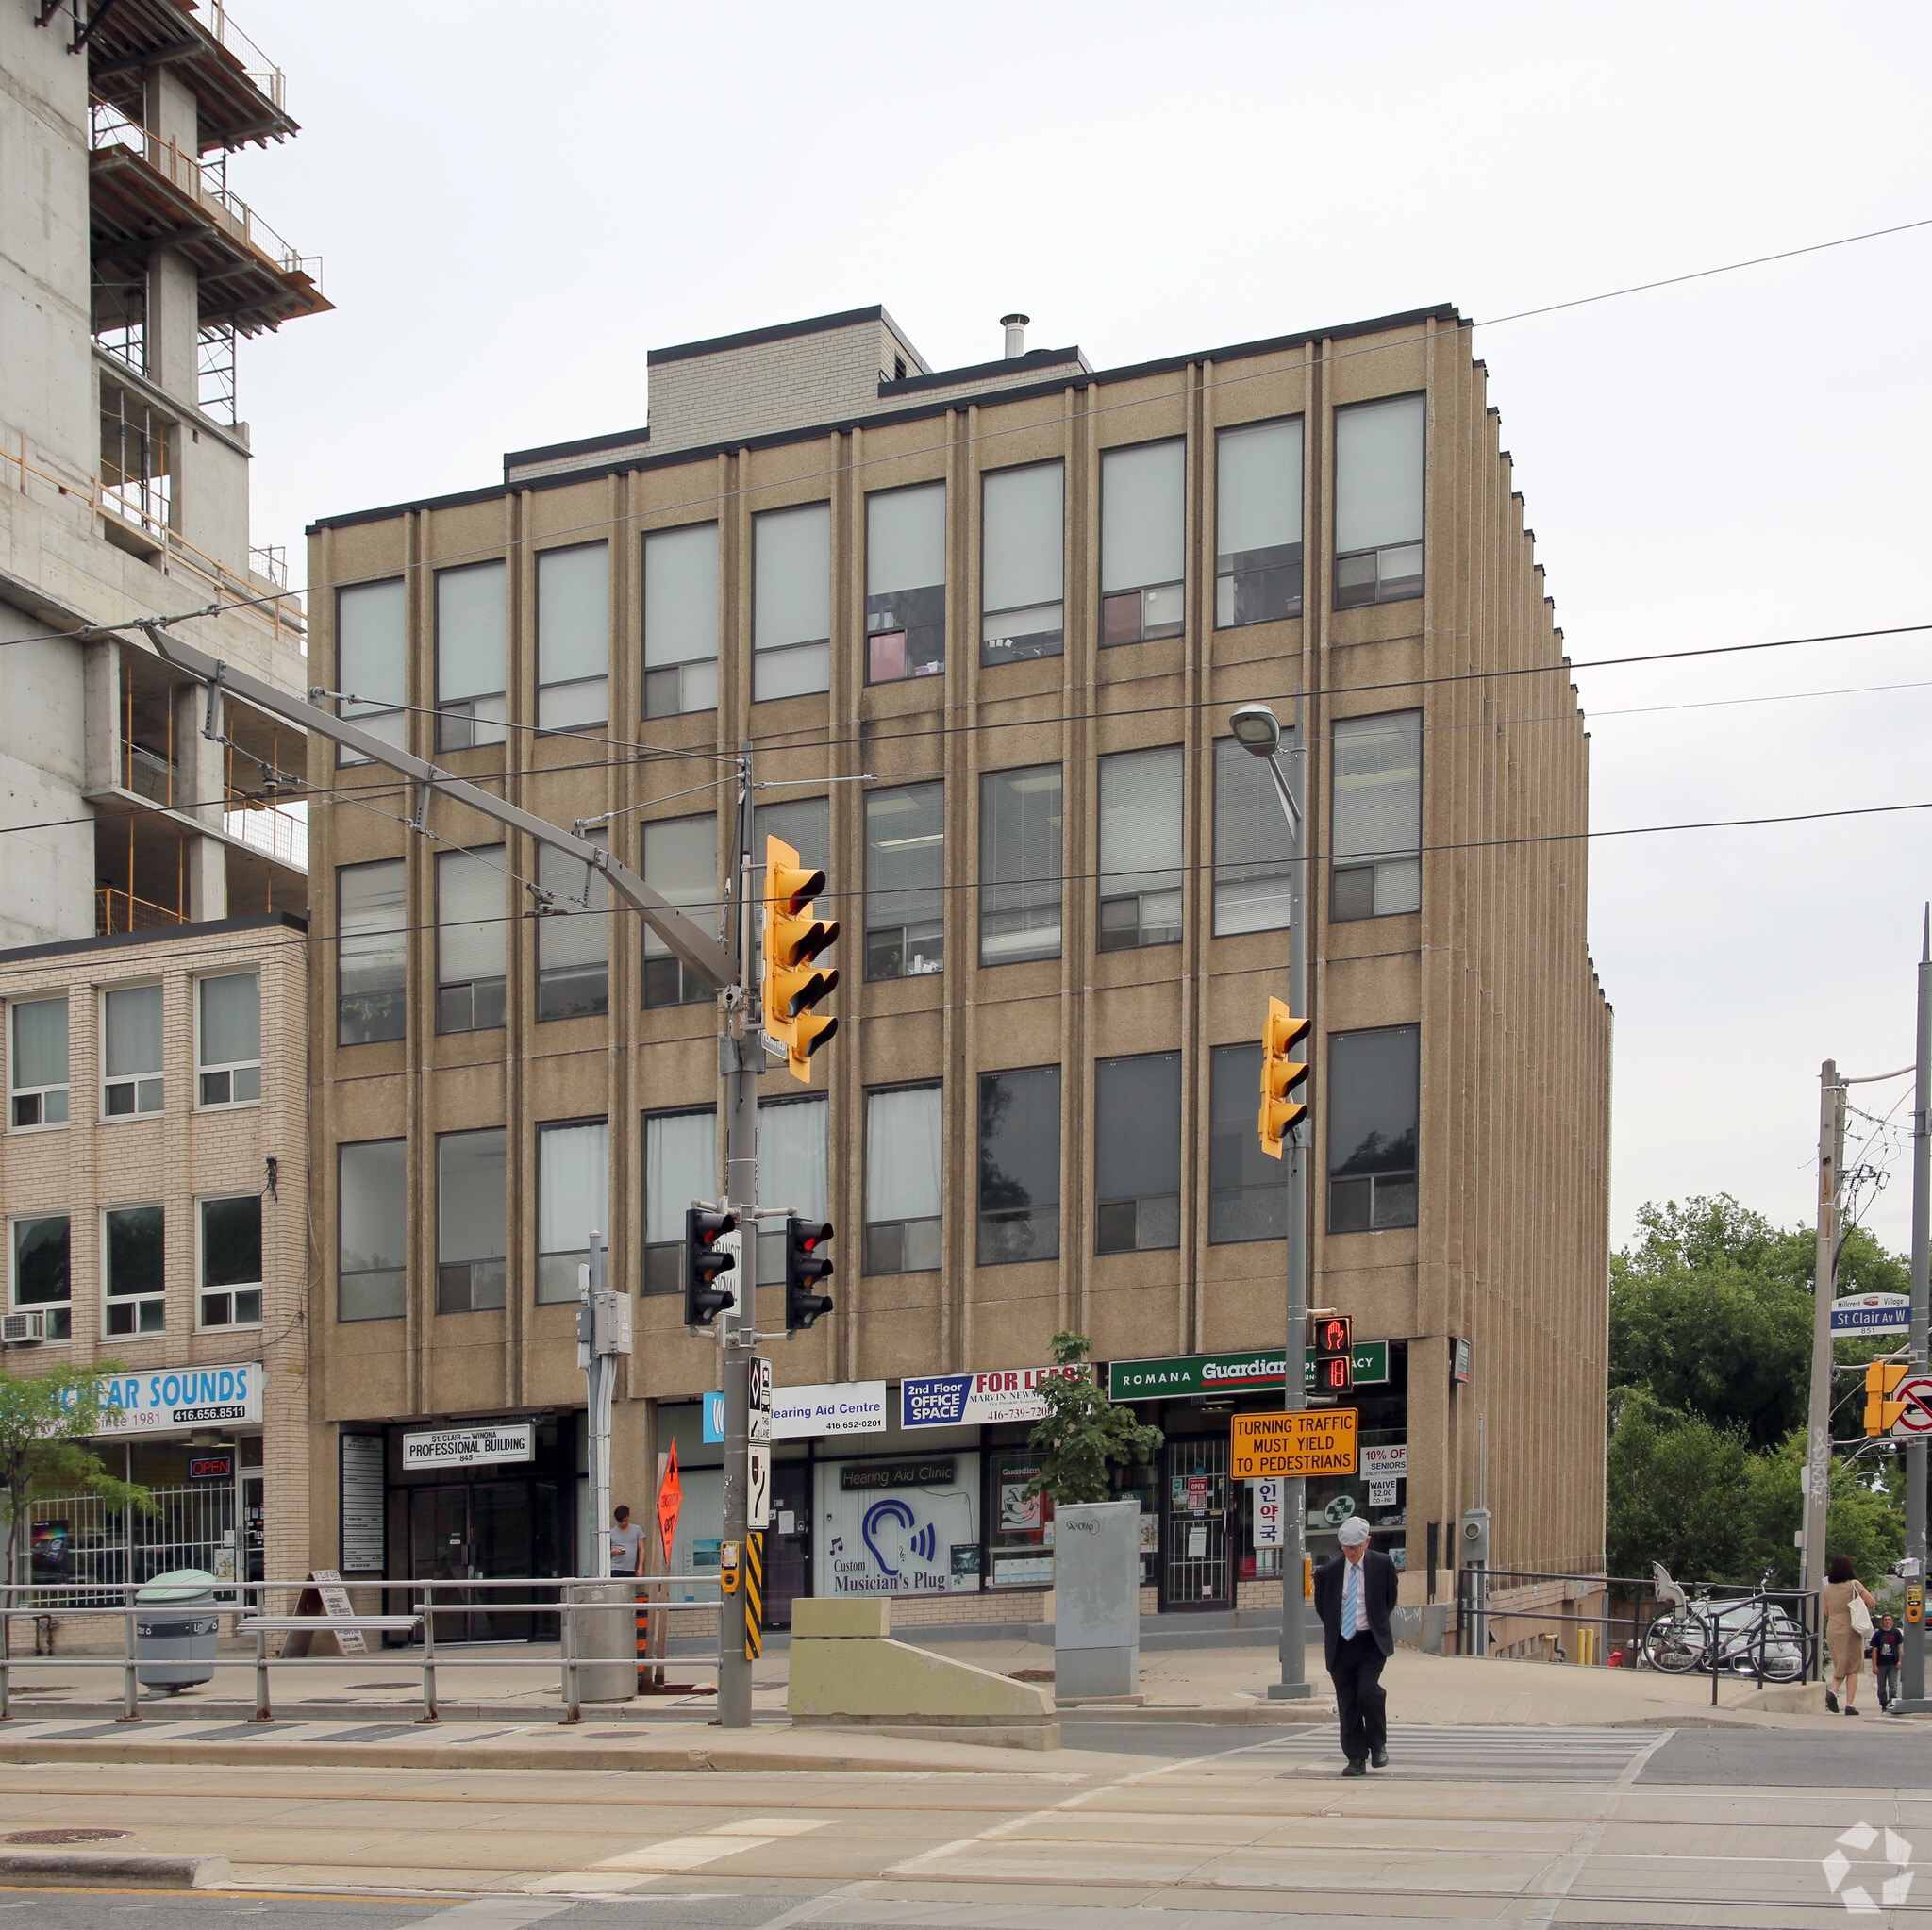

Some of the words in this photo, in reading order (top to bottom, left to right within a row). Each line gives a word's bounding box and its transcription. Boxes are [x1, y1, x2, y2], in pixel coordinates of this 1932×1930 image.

[1884, 1297, 1904, 1306] Village
[1838, 1313, 1849, 1325] St
[1852, 1311, 1880, 1324] Clair
[1895, 1309, 1906, 1322] W
[1123, 1372, 1191, 1385] ROMANA
[1331, 1359, 1344, 1387] 18
[150, 1369, 247, 1407] SOUNDS
[908, 1386, 929, 1395] 2nd
[933, 1383, 963, 1393] Floor
[976, 1372, 1018, 1393] FOR
[910, 1394, 960, 1408] OFFICE
[970, 1393, 1006, 1403] MARVIN
[174, 1406, 244, 1421] 416.656.8511
[815, 1405, 835, 1415] Aid
[839, 1403, 880, 1414] Centre
[912, 1406, 959, 1421] SPACE
[132, 1412, 160, 1425] 1981
[842, 1420, 881, 1428] 652-0201
[1238, 1419, 1292, 1435] TURNING
[1298, 1416, 1353, 1432] TRAFFIC
[409, 1440, 480, 1457] PROFESSIONAL
[485, 1437, 525, 1452] BUILDING
[1253, 1438, 1289, 1453] MUST
[1297, 1436, 1334, 1451] YIELD
[1365, 1450, 1387, 1460] 10%
[1390, 1448, 1407, 1459] OF
[192, 1460, 229, 1474] OPEN
[1237, 1458, 1253, 1472] TO
[1260, 1454, 1351, 1471] PEDESTRIANS
[1371, 1461, 1406, 1470] SENIORS
[842, 1472, 890, 1487] Hearing
[893, 1470, 914, 1481] Aid
[919, 1467, 952, 1480] Clinic
[1002, 1467, 1041, 1475] Guardian
[834, 1559, 866, 1572] Custom
[835, 1573, 909, 1592] Musician's
[914, 1572, 945, 1591] Plug
